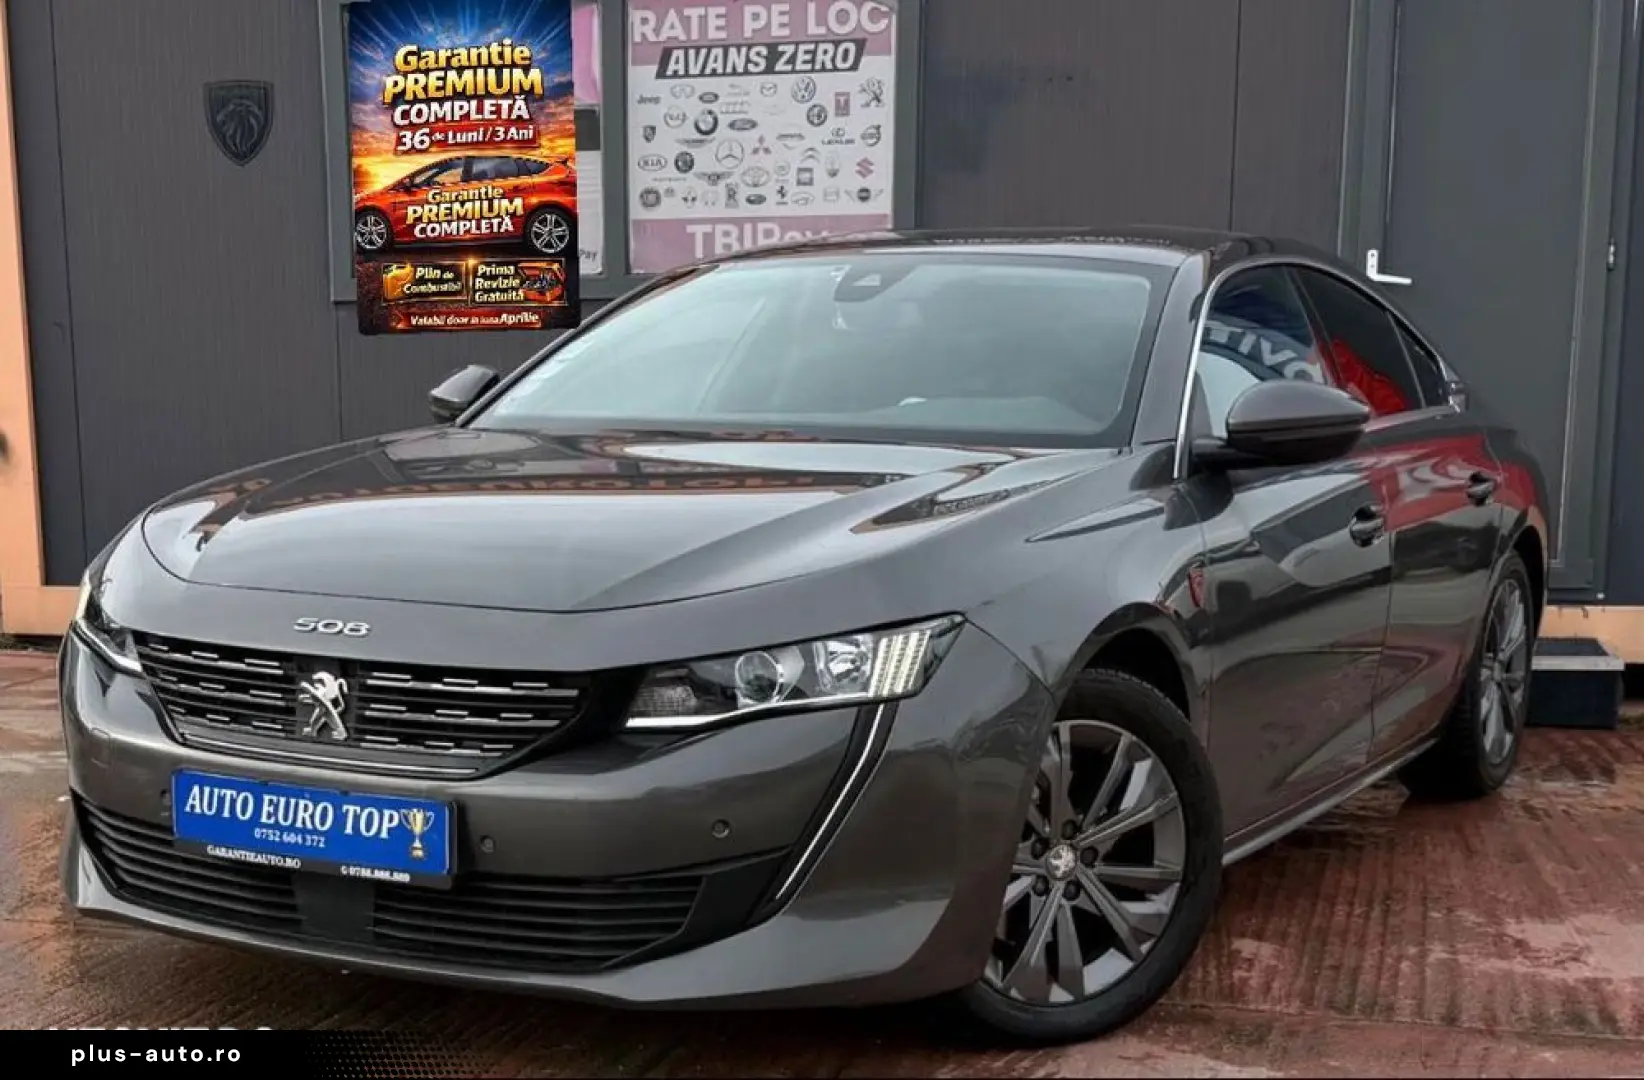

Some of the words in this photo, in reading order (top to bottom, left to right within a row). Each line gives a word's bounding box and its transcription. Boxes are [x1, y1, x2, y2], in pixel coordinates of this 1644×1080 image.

[632, 6, 727, 42] RATE
[743, 3, 790, 38] PE
[807, 0, 889, 35] LOC
[394, 38, 532, 72] Garantie
[666, 45, 767, 76] AVANS
[774, 41, 856, 72] ZERO
[383, 67, 544, 104] PREMIUM
[393, 95, 530, 126] COMPLETĂ
[397, 128, 430, 151] 36
[448, 128, 484, 144] Luni
[494, 126, 505, 141] 3
[508, 125, 533, 140] Ani
[427, 185, 504, 204] Garantie
[406, 198, 524, 225] PREMIUM
[415, 266, 441, 279] Plin
[475, 277, 520, 289] Revizie
[477, 264, 516, 276] Prima
[293, 617, 370, 637] 508
[184, 784, 254, 821] AUTO
[260, 793, 334, 831] EURO
[341, 804, 400, 839] TOP
